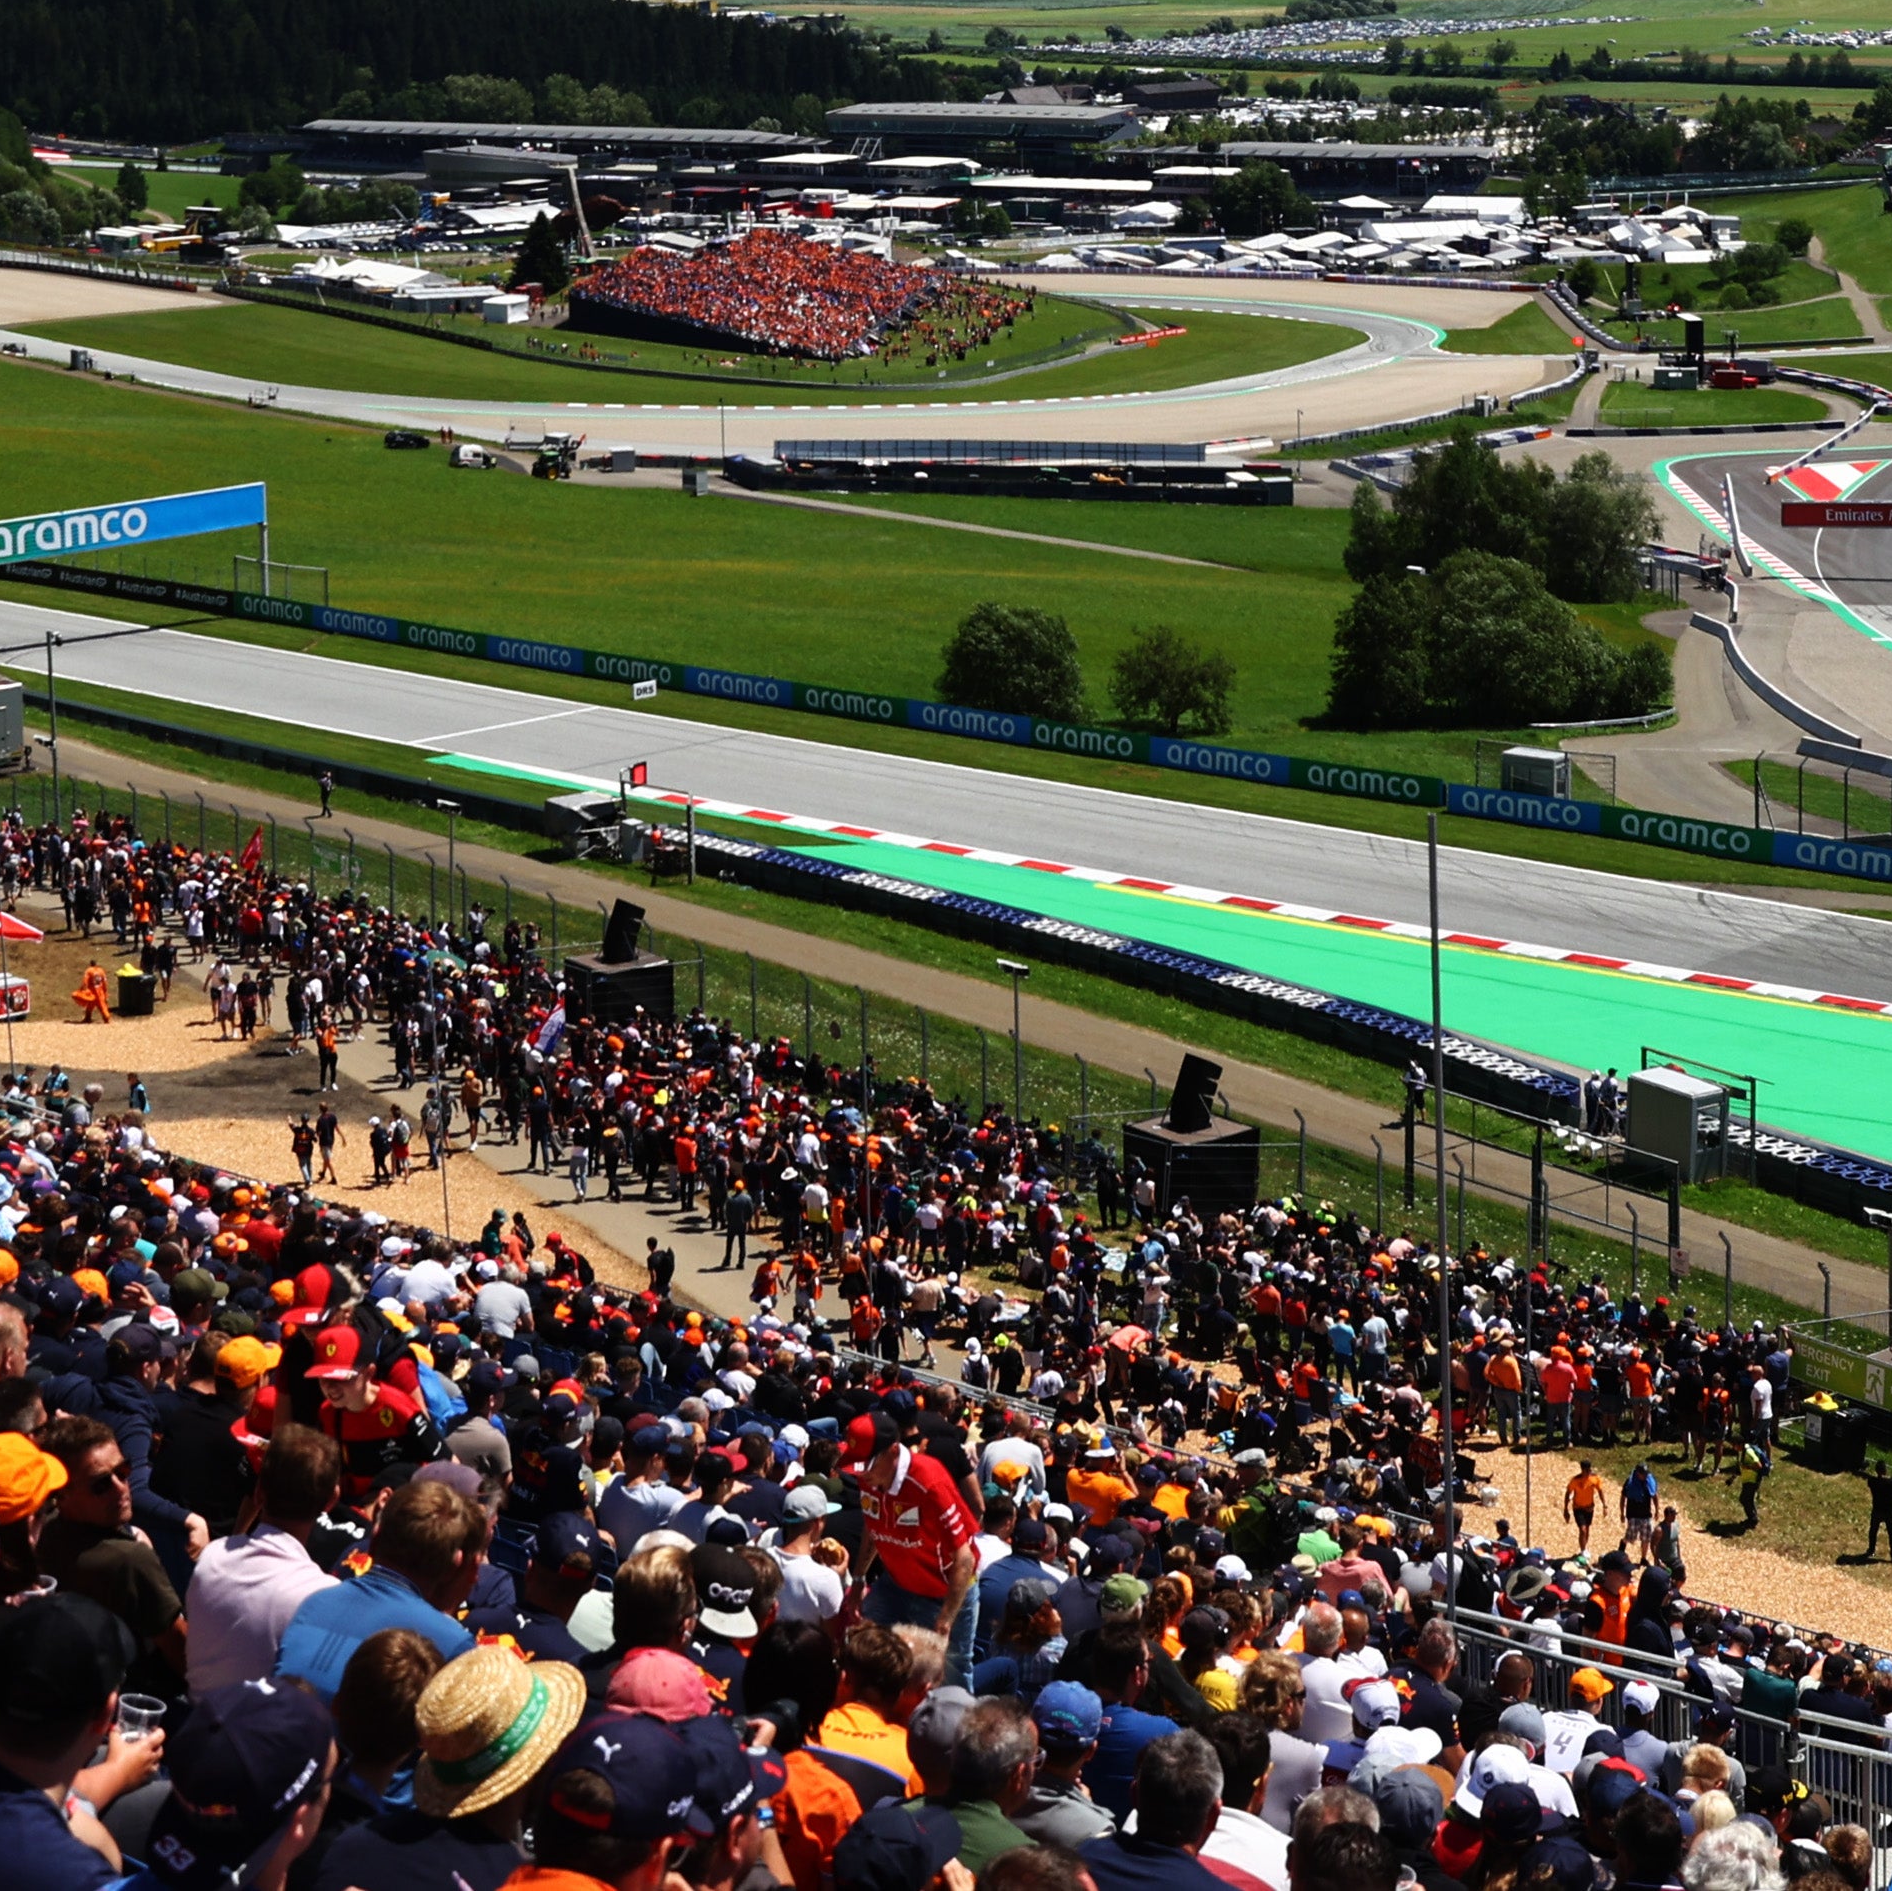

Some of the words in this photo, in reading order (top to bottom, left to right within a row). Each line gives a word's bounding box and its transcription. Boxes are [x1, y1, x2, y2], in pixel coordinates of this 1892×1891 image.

[1825, 509, 1883, 522] Emirates
[243, 596, 302, 621] aramco
[323, 611, 387, 635] aramco
[409, 625, 475, 652] aramco
[499, 640, 571, 667] aramco
[596, 655, 671, 683] aramco
[636, 685, 654, 696] DRS
[698, 671, 778, 701] aramco
[806, 688, 892, 718] aramco
[923, 706, 1014, 737] aramco
[1035, 724, 1133, 756] aramco
[1167, 744, 1271, 778] aramco
[1308, 765, 1419, 798] aramco
[1462, 790, 1581, 826] aramco
[1620, 813, 1750, 853] aramco
[1805, 1363, 1831, 1382] EXIT
[871, 1529, 924, 1549] Santander
[1552, 1731, 1573, 1755] 4
[155, 1834, 197, 1871] 33
